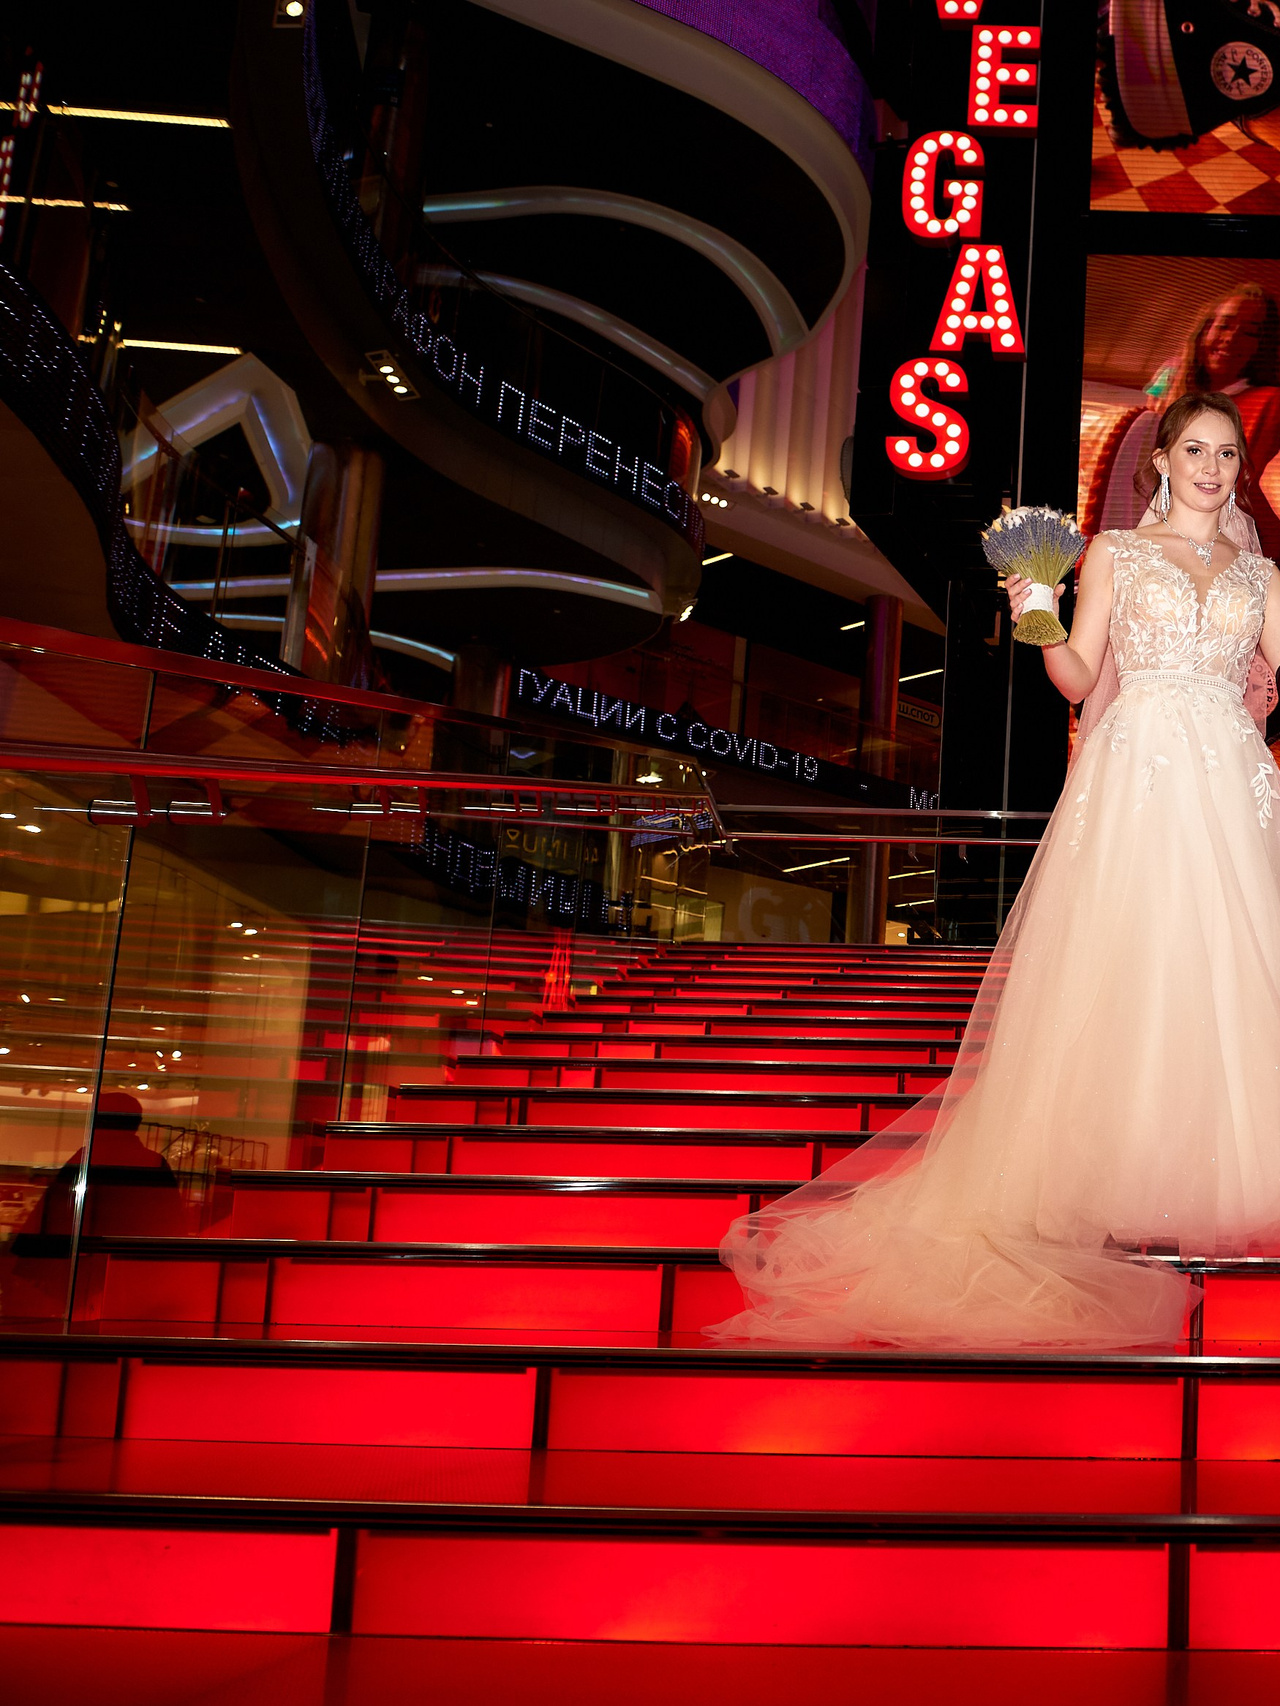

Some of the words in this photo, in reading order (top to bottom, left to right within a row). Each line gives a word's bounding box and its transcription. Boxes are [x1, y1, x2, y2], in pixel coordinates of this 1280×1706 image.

[885, 0, 1042, 481] EGAS
[655, 712, 678, 741] С
[686, 721, 819, 783] COVID-19
